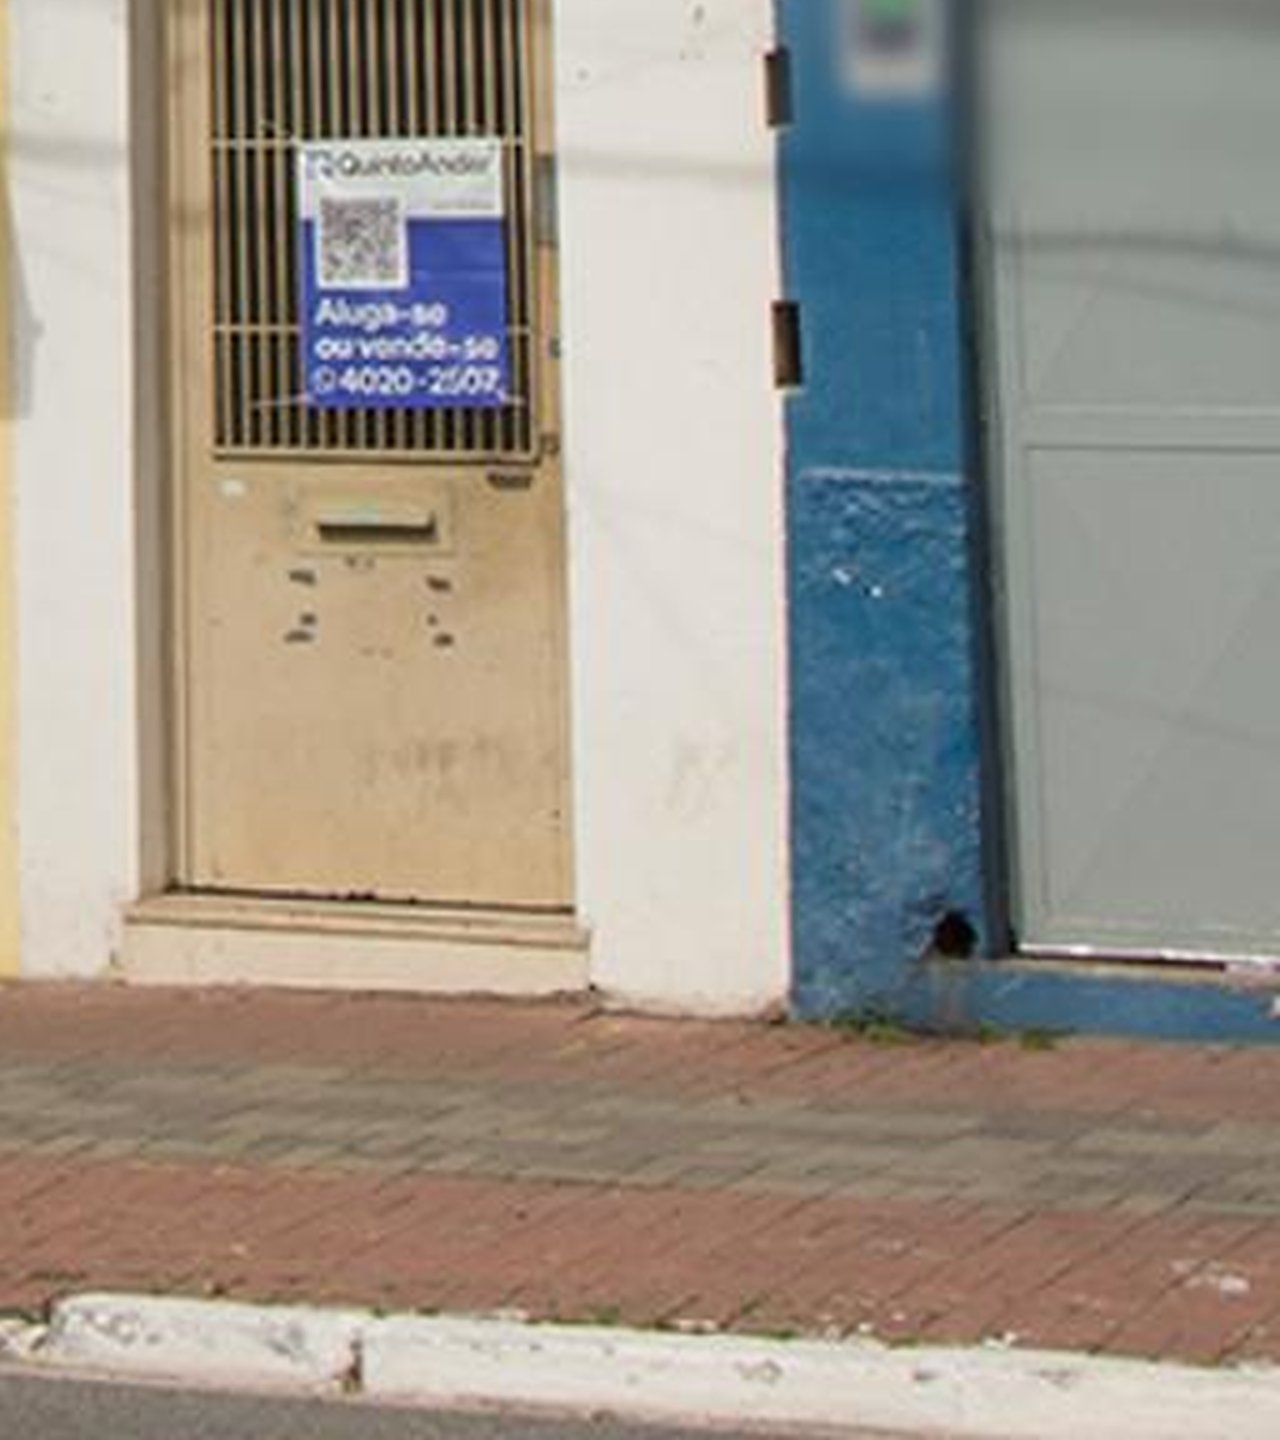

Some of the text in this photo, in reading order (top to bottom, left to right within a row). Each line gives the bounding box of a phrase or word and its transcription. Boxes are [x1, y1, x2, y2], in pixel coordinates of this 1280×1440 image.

[314, 297, 447, 332] Aluga-se
[314, 331, 500, 361] ou vende-se
